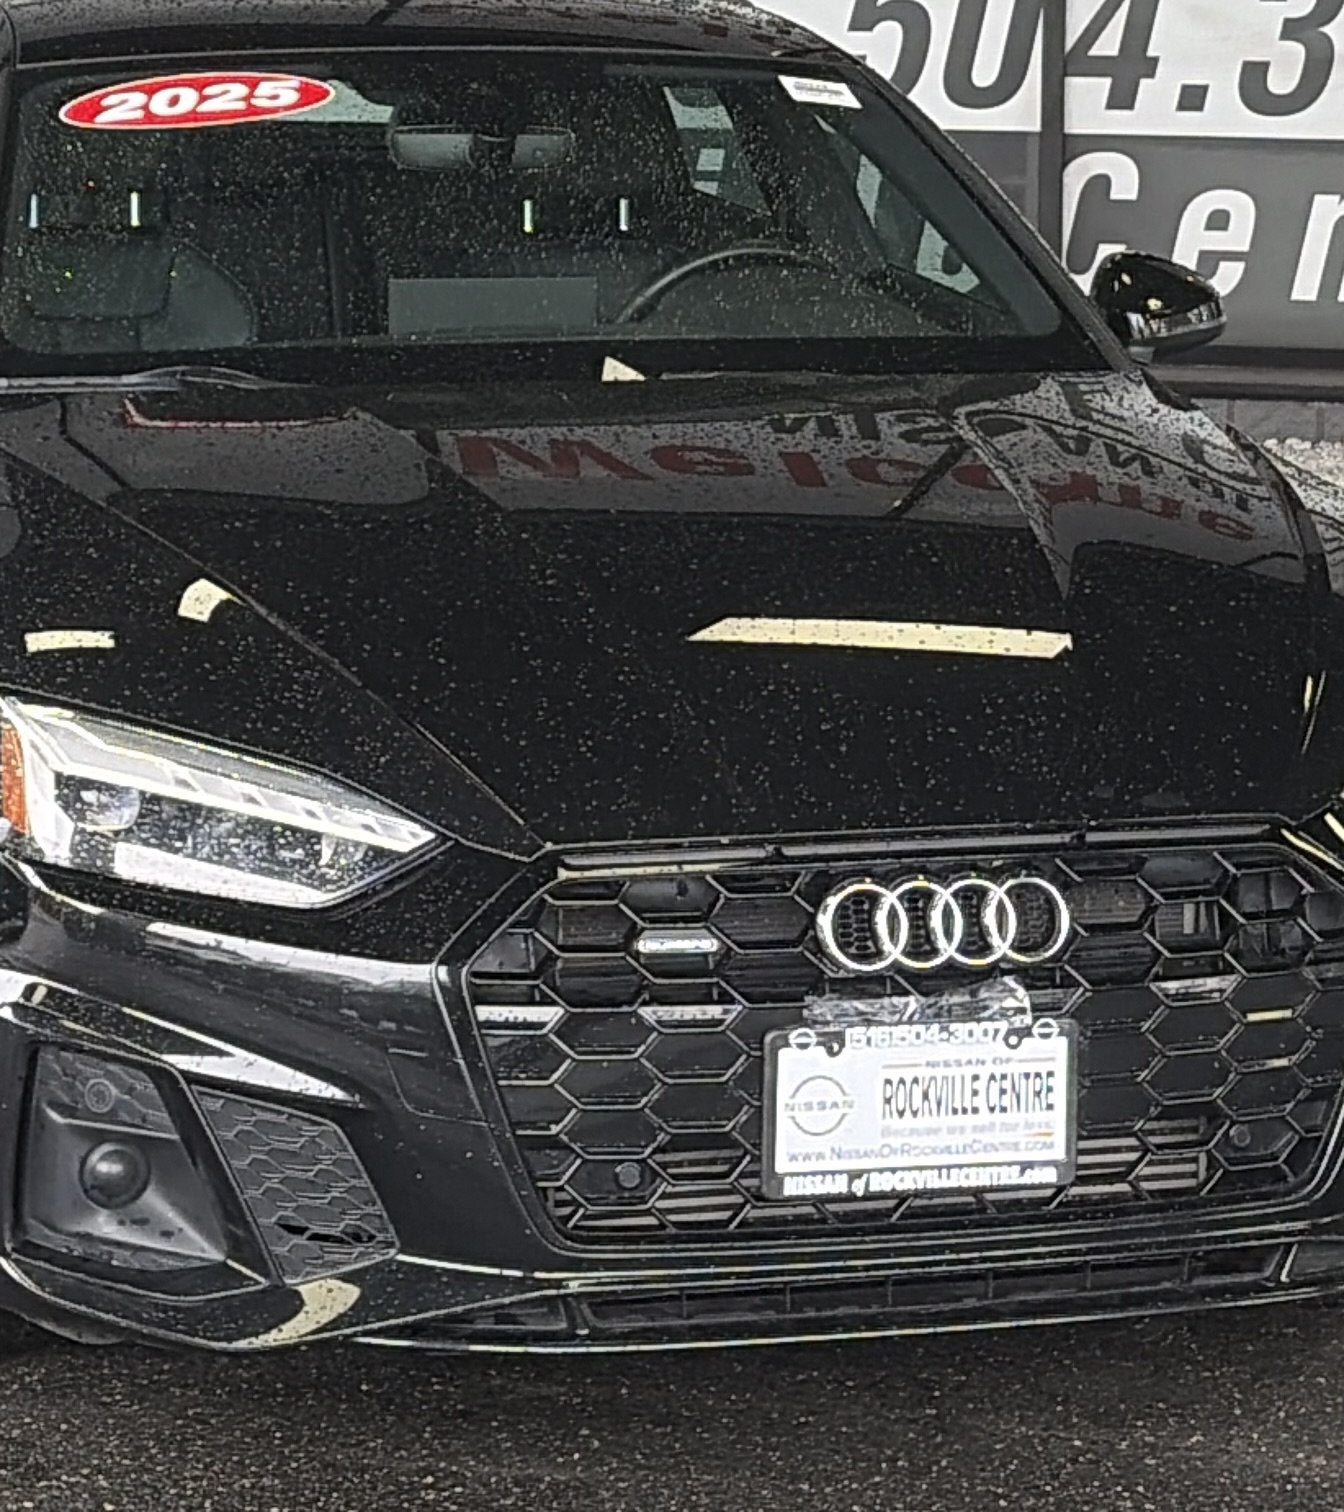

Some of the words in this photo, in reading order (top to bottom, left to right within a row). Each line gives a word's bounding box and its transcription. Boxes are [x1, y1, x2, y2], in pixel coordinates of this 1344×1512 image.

[93, 80, 302, 123] 2025
[784, 1100, 854, 1112] NISSAN
[881, 1073, 980, 1120] ROCKVILLE
[986, 1070, 1054, 1114] CENTRE
